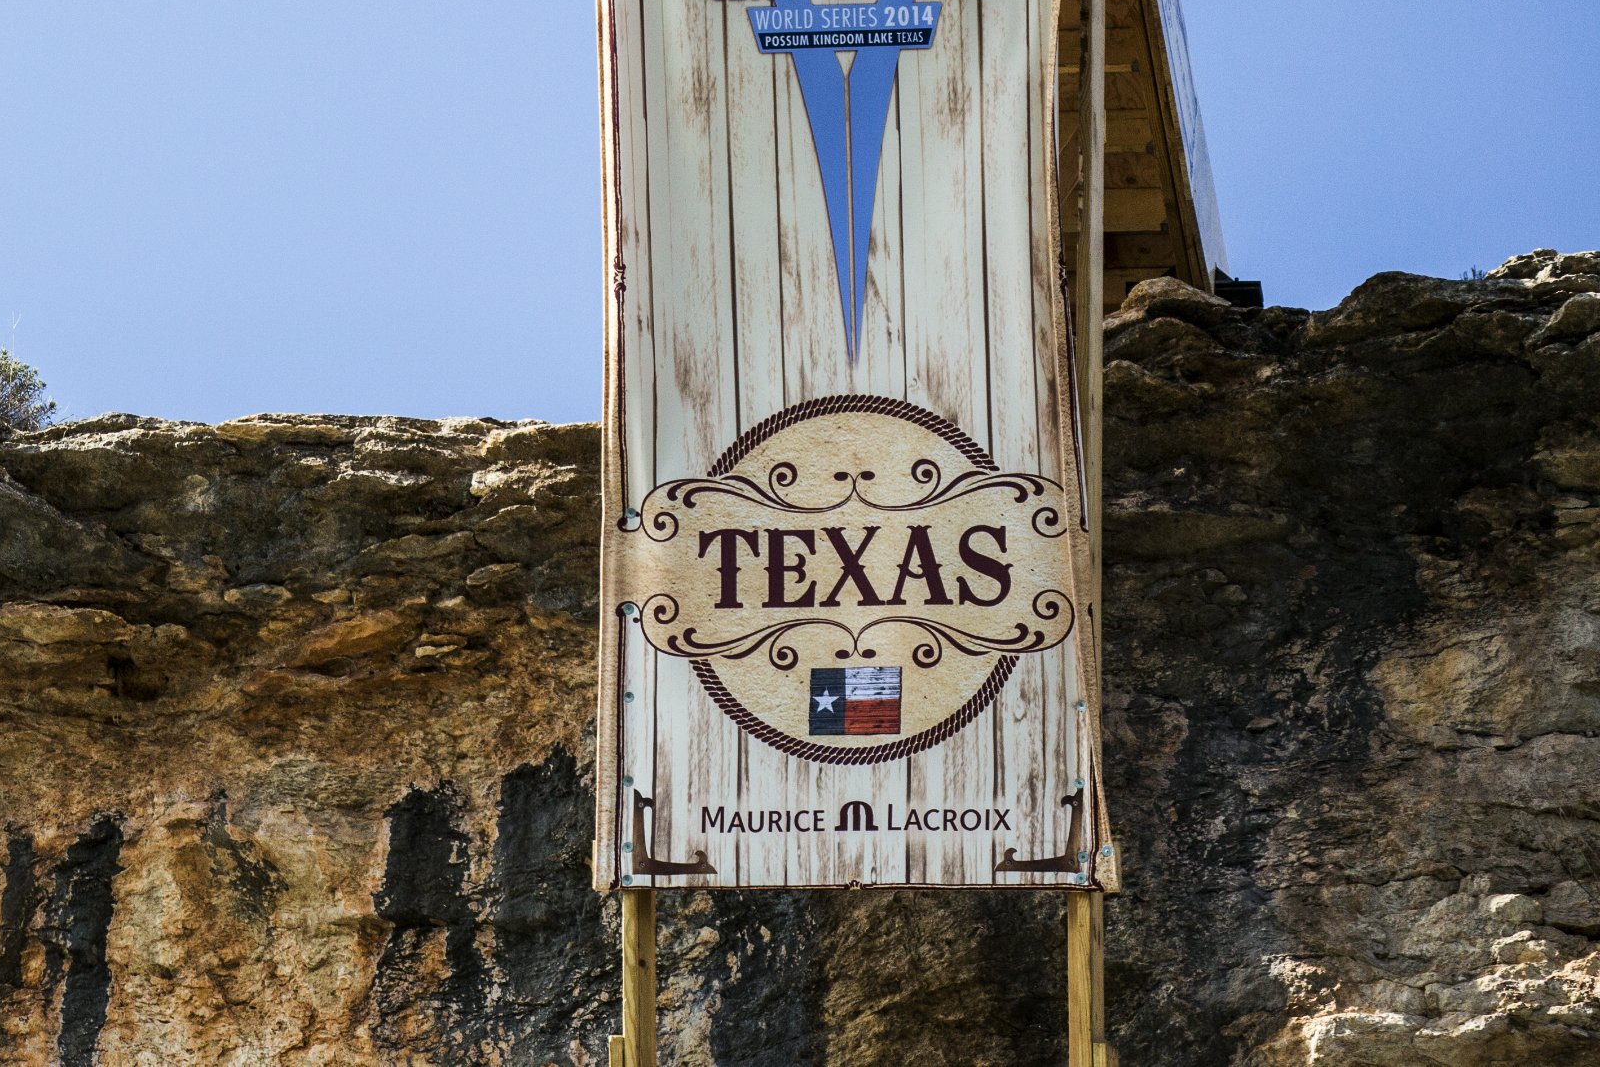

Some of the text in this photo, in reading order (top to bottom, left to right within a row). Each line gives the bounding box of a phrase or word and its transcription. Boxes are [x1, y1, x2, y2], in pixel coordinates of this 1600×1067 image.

[755, 5, 934, 30] WORLD SERIES 2014
[765, 31, 924, 47] POSSUM KINGDOM LAKE TEXAS
[697, 525, 1014, 609] TEXAS
[701, 806, 825, 833] MAURICE
[887, 803, 1012, 831] LACROIX
